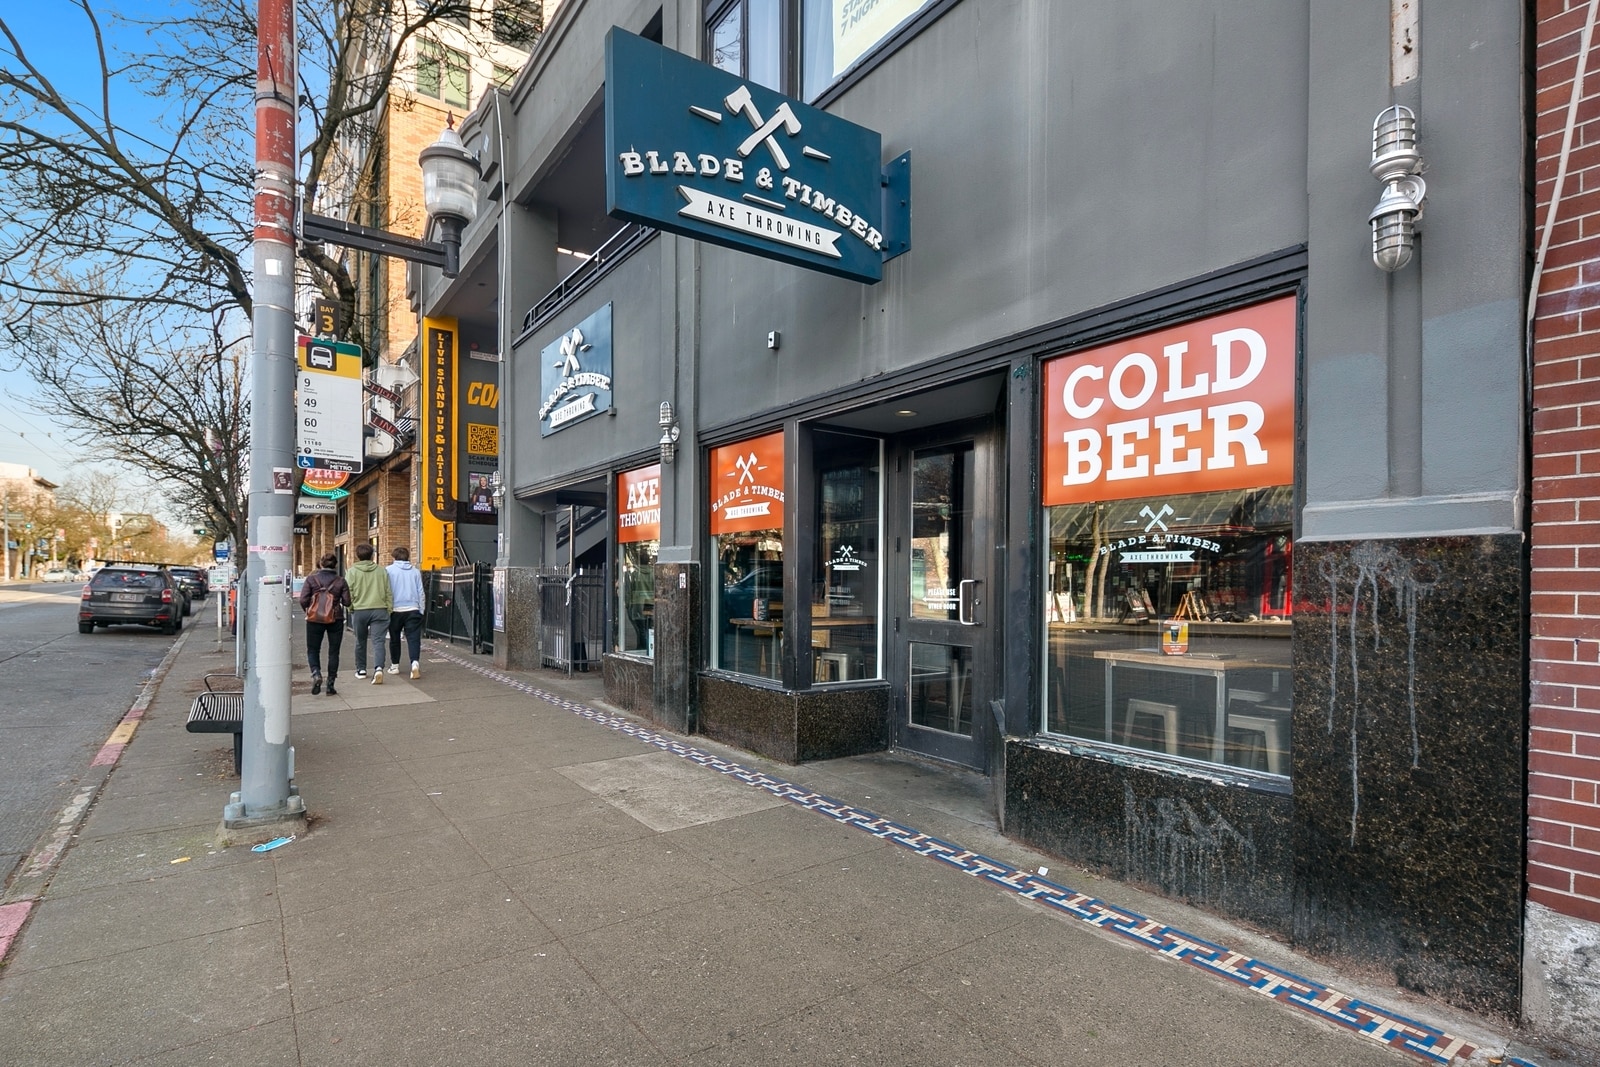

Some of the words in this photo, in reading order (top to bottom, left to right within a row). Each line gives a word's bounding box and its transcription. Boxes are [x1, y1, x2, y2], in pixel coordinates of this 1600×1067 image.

[841, 20, 848, 36] 7
[619, 151, 744, 182] BLADE
[756, 168, 773, 189] &
[782, 176, 884, 250] TIMBER
[707, 200, 735, 221] AXE
[746, 211, 822, 245] THROWING
[320, 305, 335, 313] BAY
[322, 315, 334, 332] 3
[436, 332, 445, 365] LIVE
[303, 377, 311, 387] 9
[1062, 327, 1267, 420] COLD
[303, 398, 317, 408] 49
[304, 417, 317, 428] 60
[435, 434, 446, 444] &
[1062, 400, 1268, 486] BEER
[305, 468, 342, 479] PIKE
[436, 446, 444, 485] PATIO
[436, 487, 445, 510] BAR
[627, 478, 659, 510] AXE
[712, 488, 741, 512] BLADE
[743, 486, 749, 495] &
[1099, 535, 1147, 555] BLADE
[1152, 533, 1160, 543] &
[1165, 534, 1221, 553] TIMBER
